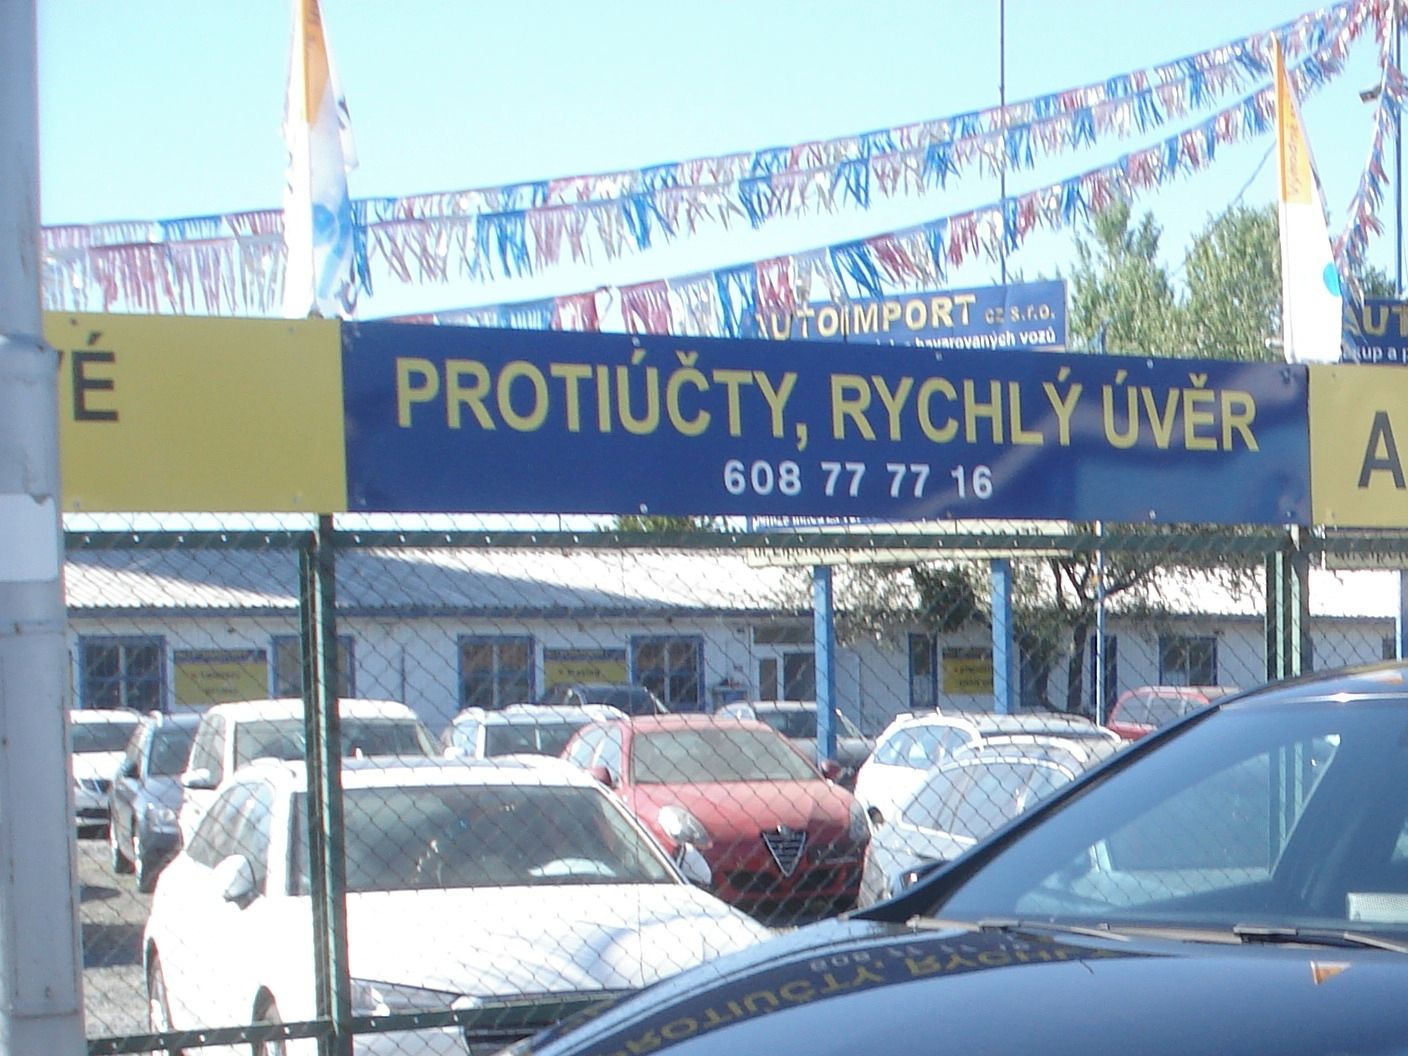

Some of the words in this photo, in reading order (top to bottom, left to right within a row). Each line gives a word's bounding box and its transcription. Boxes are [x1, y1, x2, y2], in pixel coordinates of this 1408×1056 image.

[1010, 304, 1056, 324] s.r.o.
[1387, 346, 1397, 361] a
[394, 349, 808, 450] PROTIÚČTY,
[831, 365, 1083, 447] RYCHLÝ
[1103, 370, 1260, 453] ÚVĚR
[723, 459, 802, 496] 608
[820, 462, 866, 498] 77
[886, 463, 930, 499] 77
[950, 464, 993, 500] 16
